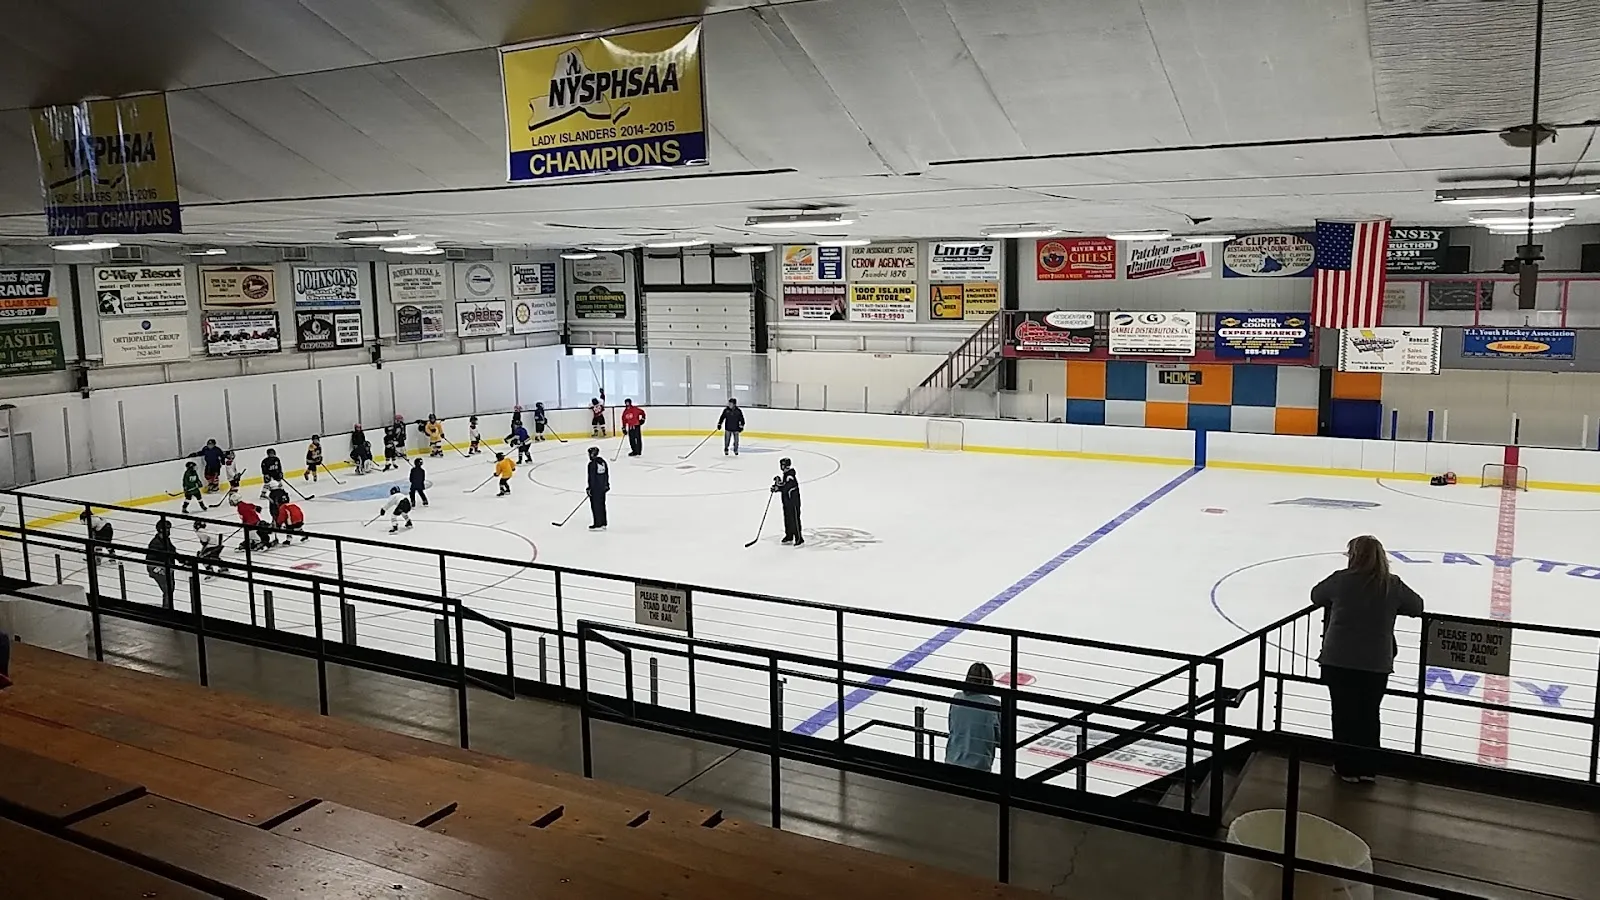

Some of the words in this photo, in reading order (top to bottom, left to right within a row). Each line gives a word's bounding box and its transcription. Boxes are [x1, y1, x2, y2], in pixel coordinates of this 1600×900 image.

[549, 62, 679, 108] NYSPHSAA
[531, 134, 556, 147] LADY
[560, 128, 616, 144] ISLANDERS
[621, 121, 675, 137] 2014-2015
[64, 132, 156, 168] NPHSAA
[530, 139, 681, 176] CHAMPIONS
[48, 215, 84, 228] ection
[101, 208, 173, 228] CHAMPIONS
[1246, 236, 1287, 246] CLIPPER
[1069, 252, 1114, 263] CHEESE
[1131, 245, 1169, 261] Patchen
[852, 258, 876, 268] CEROW
[878, 258, 905, 268] AGENCY
[1130, 257, 1172, 272] Painting
[20, 272, 45, 283] Agency
[99, 269, 138, 282] C-Way
[140, 268, 181, 278] Resort
[393, 268, 412, 279] ROBERT
[297, 268, 358, 294] JOHNSON'S
[0, 284, 43, 296] RANCE
[460, 310, 503, 324] FORBES
[113, 335, 157, 343] ORTHOPAEDIC
[1164, 372, 1196, 384] HOME
[640, 591, 658, 601] PLEASE
[661, 594, 668, 602] DO
[671, 596, 681, 604] NOT
[644, 601, 659, 611] STAND
[662, 604, 678, 614] ALONG
[649, 611, 659, 620] THE
[661, 613, 672, 622] RAIL
[1437, 629, 1466, 640] PLEASE
[1470, 632, 1482, 642] DO
[1486, 634, 1503, 645] NOT
[1441, 640, 1467, 652] STAND
[1472, 643, 1498, 656] ALONG
[1450, 653, 1466, 663] THE
[1469, 655, 1487, 665] RAIL
[1426, 668, 1480, 695] N
[1515, 680, 1568, 707] Y
